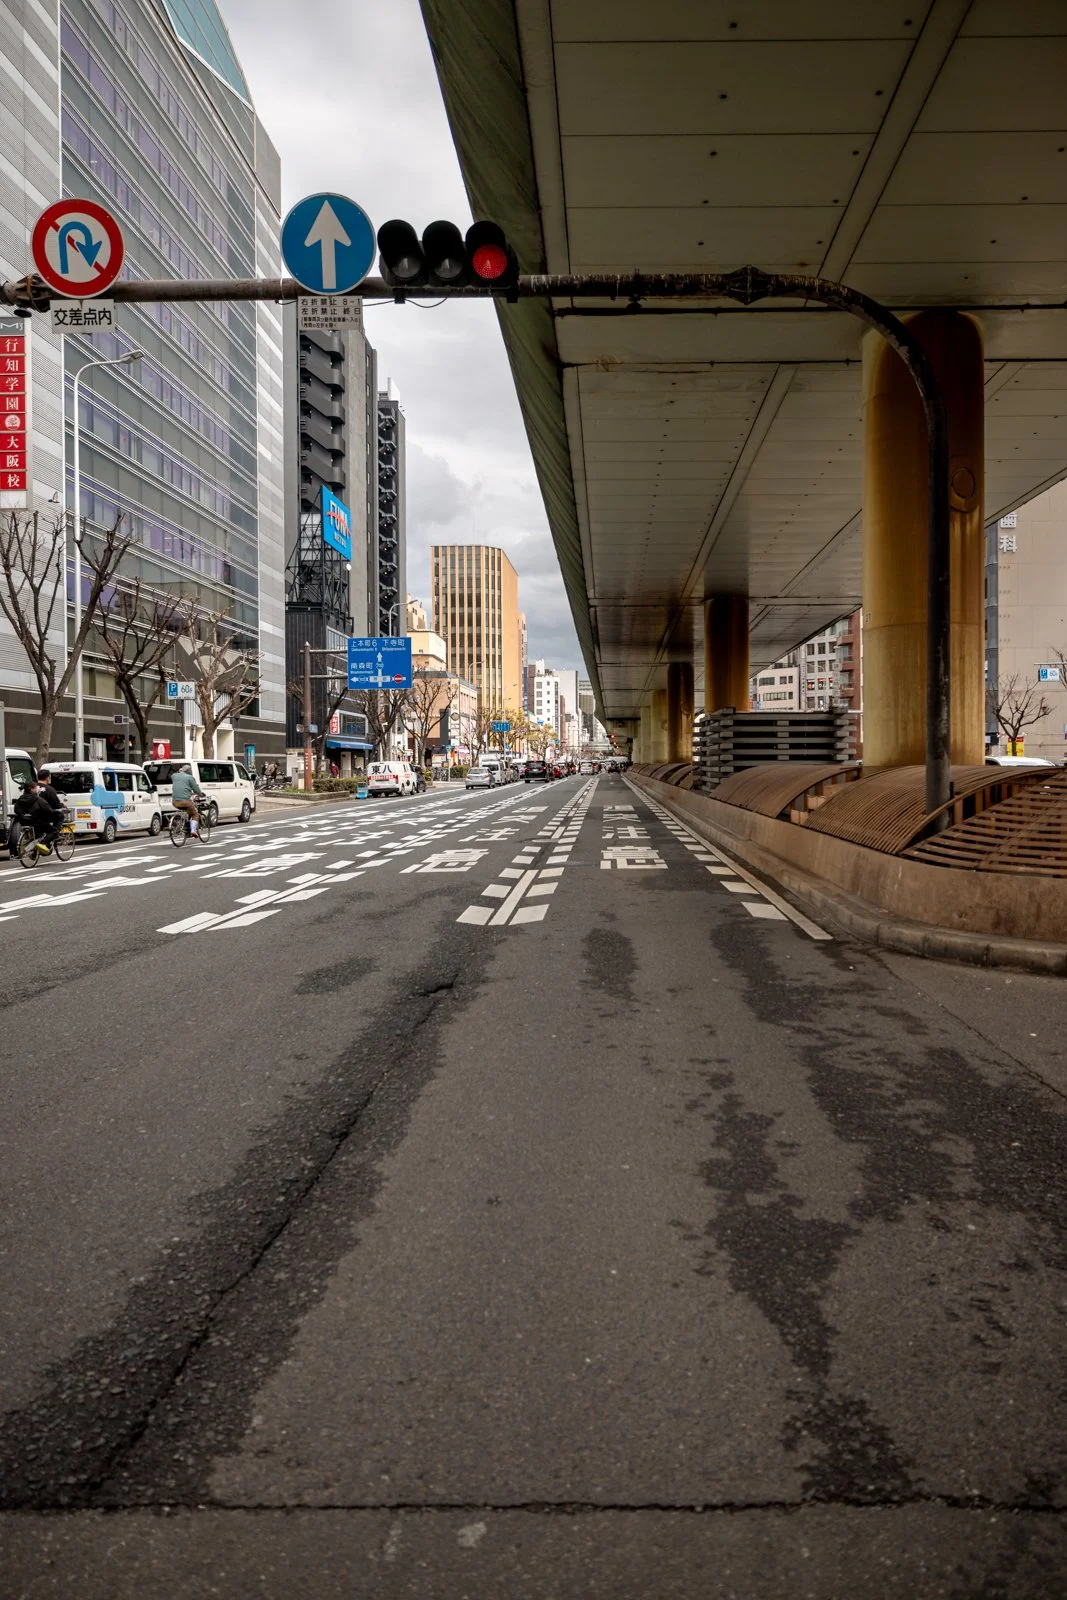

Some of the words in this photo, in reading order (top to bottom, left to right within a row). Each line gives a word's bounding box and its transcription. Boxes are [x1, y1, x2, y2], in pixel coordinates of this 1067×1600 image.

[301, 298, 337, 306] 右折禁止
[54, 308, 112, 326] 交差点内
[5, 338, 19, 410] 行知学園
[7, 436, 20, 488] 大阪校
[351, 639, 377, 648] 上本町6
[382, 639, 405, 647] 下寺町
[170, 683, 177, 691] P
[371, 764, 392, 775] 東八
